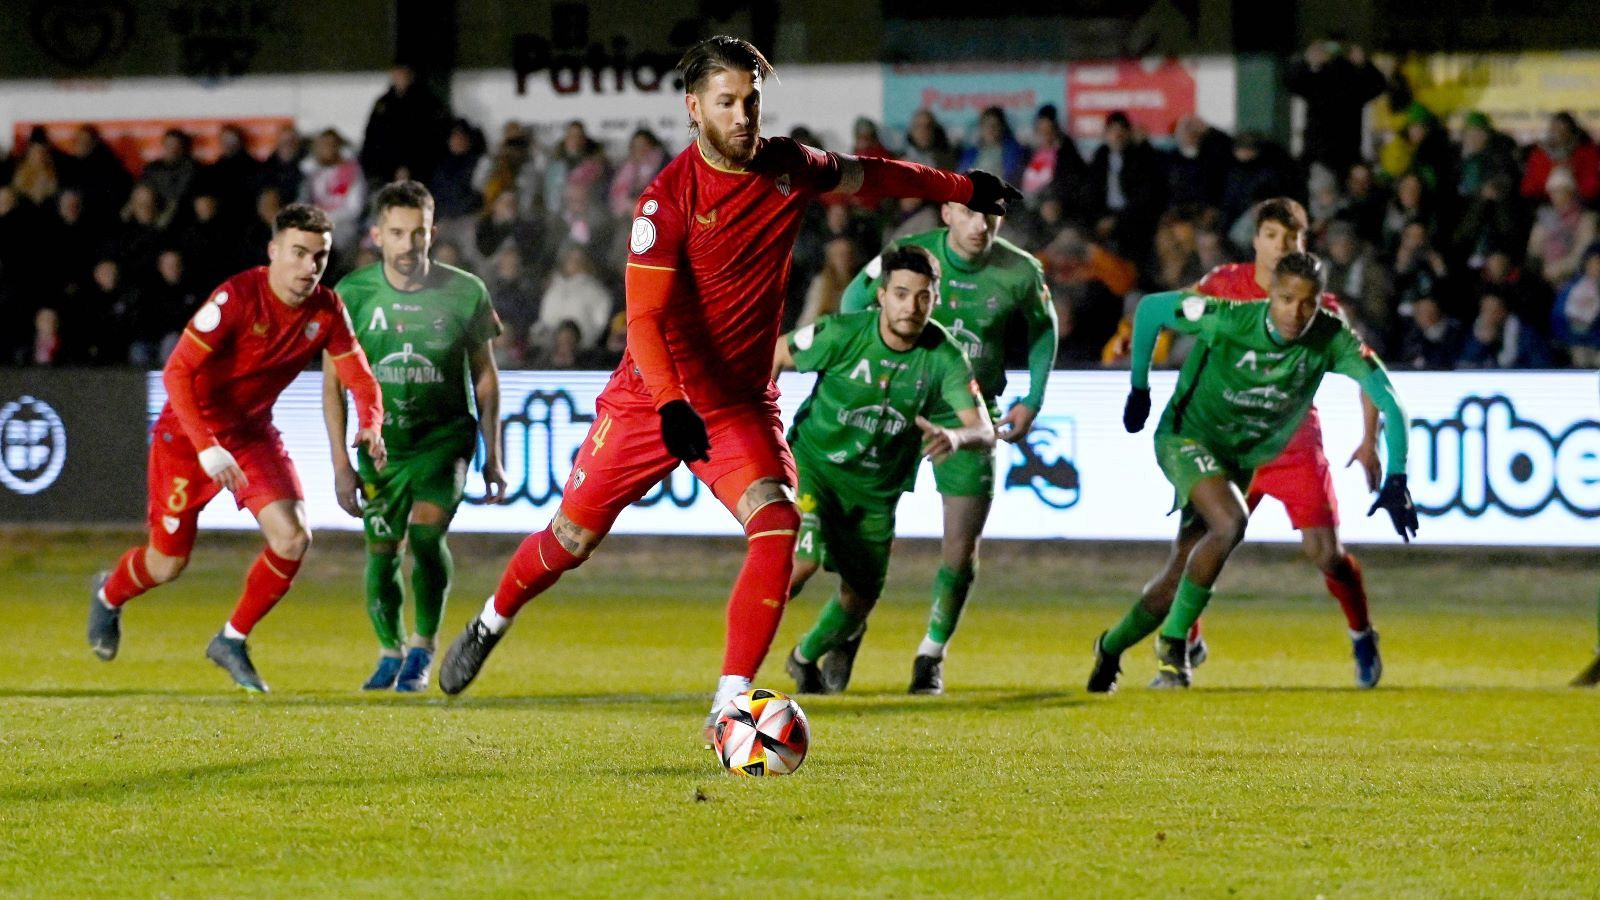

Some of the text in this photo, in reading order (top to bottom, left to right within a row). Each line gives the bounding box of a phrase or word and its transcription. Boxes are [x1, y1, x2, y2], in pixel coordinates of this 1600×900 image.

[591, 413, 613, 457] 4
[1194, 455, 1220, 473] 12
[167, 476, 190, 513] 3
